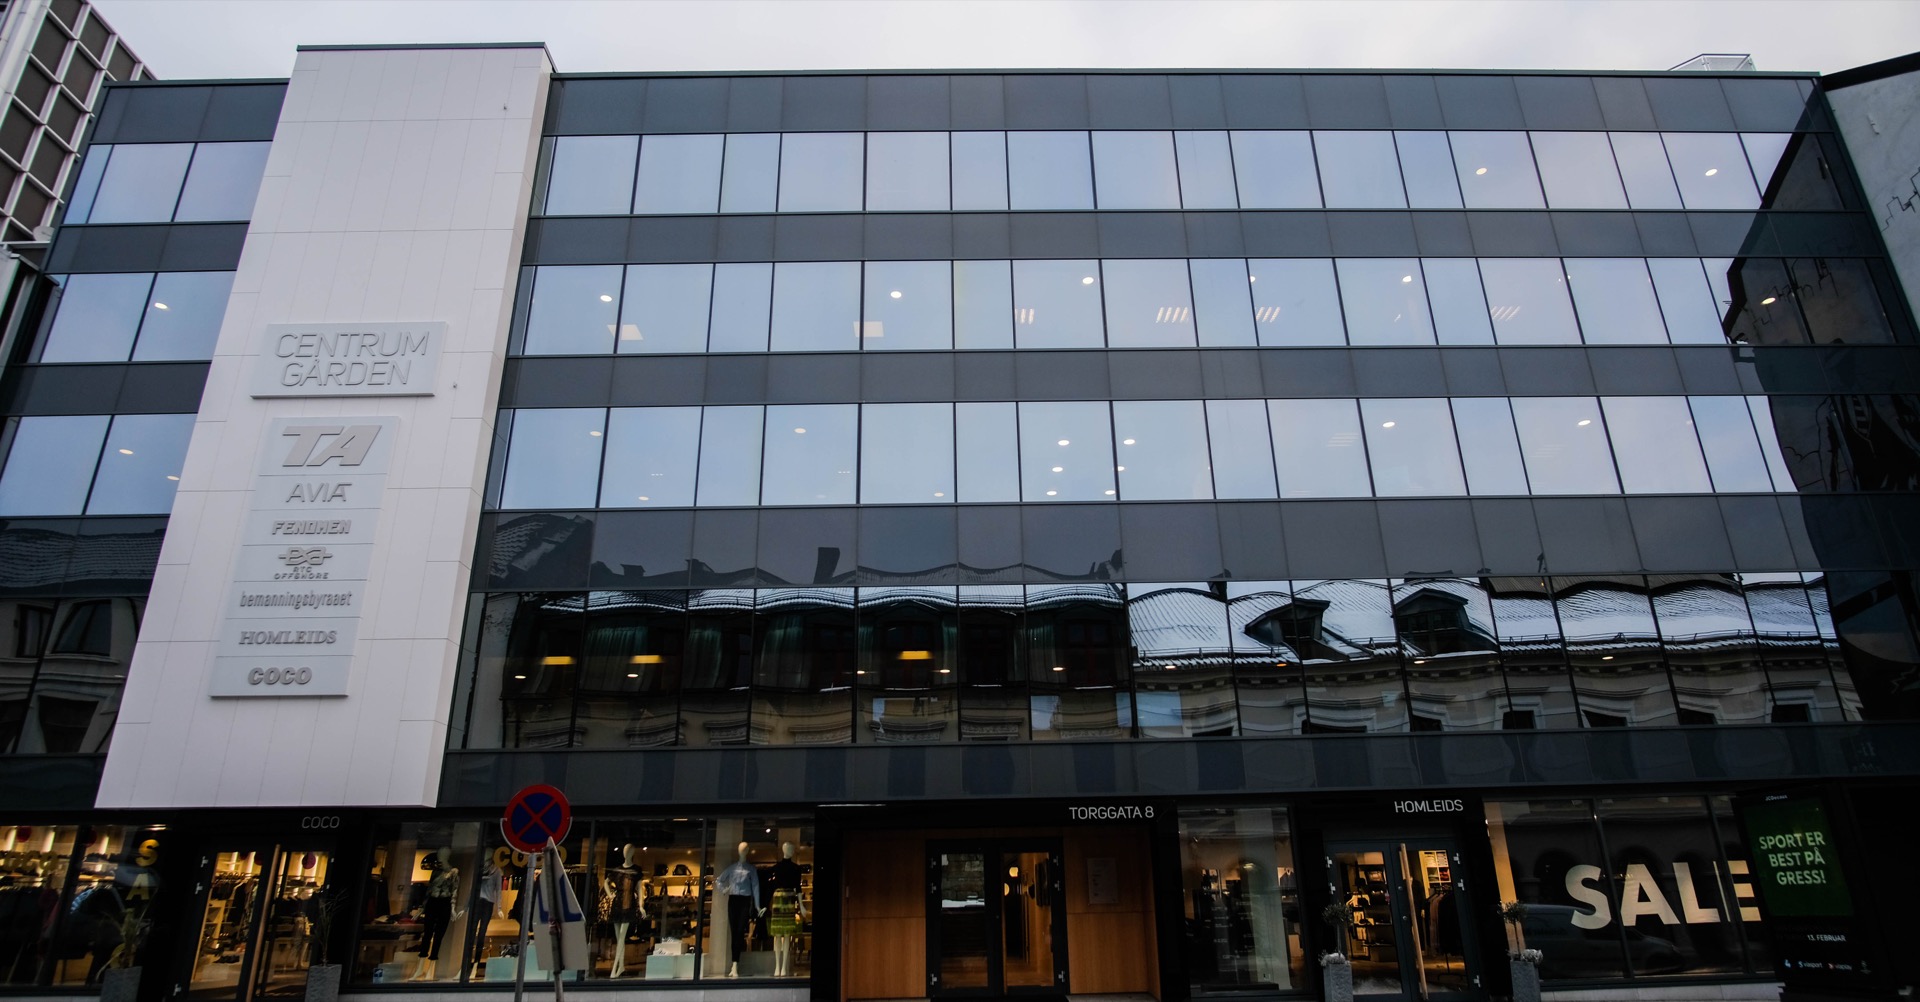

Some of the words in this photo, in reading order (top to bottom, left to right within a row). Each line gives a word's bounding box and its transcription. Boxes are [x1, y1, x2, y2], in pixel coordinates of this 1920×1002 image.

[275, 331, 429, 358] CENTRUM
[280, 359, 411, 387] GÅRDEN
[282, 425, 383, 467] TA
[271, 519, 352, 536] FENOMEN
[274, 572, 329, 580] OFFSHORE
[239, 590, 353, 610] bemanningsbyraaet
[238, 630, 338, 646] HOMLEIDS
[247, 666, 312, 685] COCO
[1068, 806, 1143, 820] TORGGATA
[1144, 805, 1155, 819] 8
[1394, 799, 1464, 814] HOMLEIDS
[301, 815, 341, 829] COCO
[1759, 834, 1803, 850] SPORT
[1805, 832, 1825, 845] ER
[1768, 851, 1801, 868] BEST
[1804, 847, 1825, 864] PÅ
[1776, 869, 1827, 887] GRESS!
[1564, 860, 1762, 930] SALE
[1817, 934, 1847, 943] FEBRUAR
